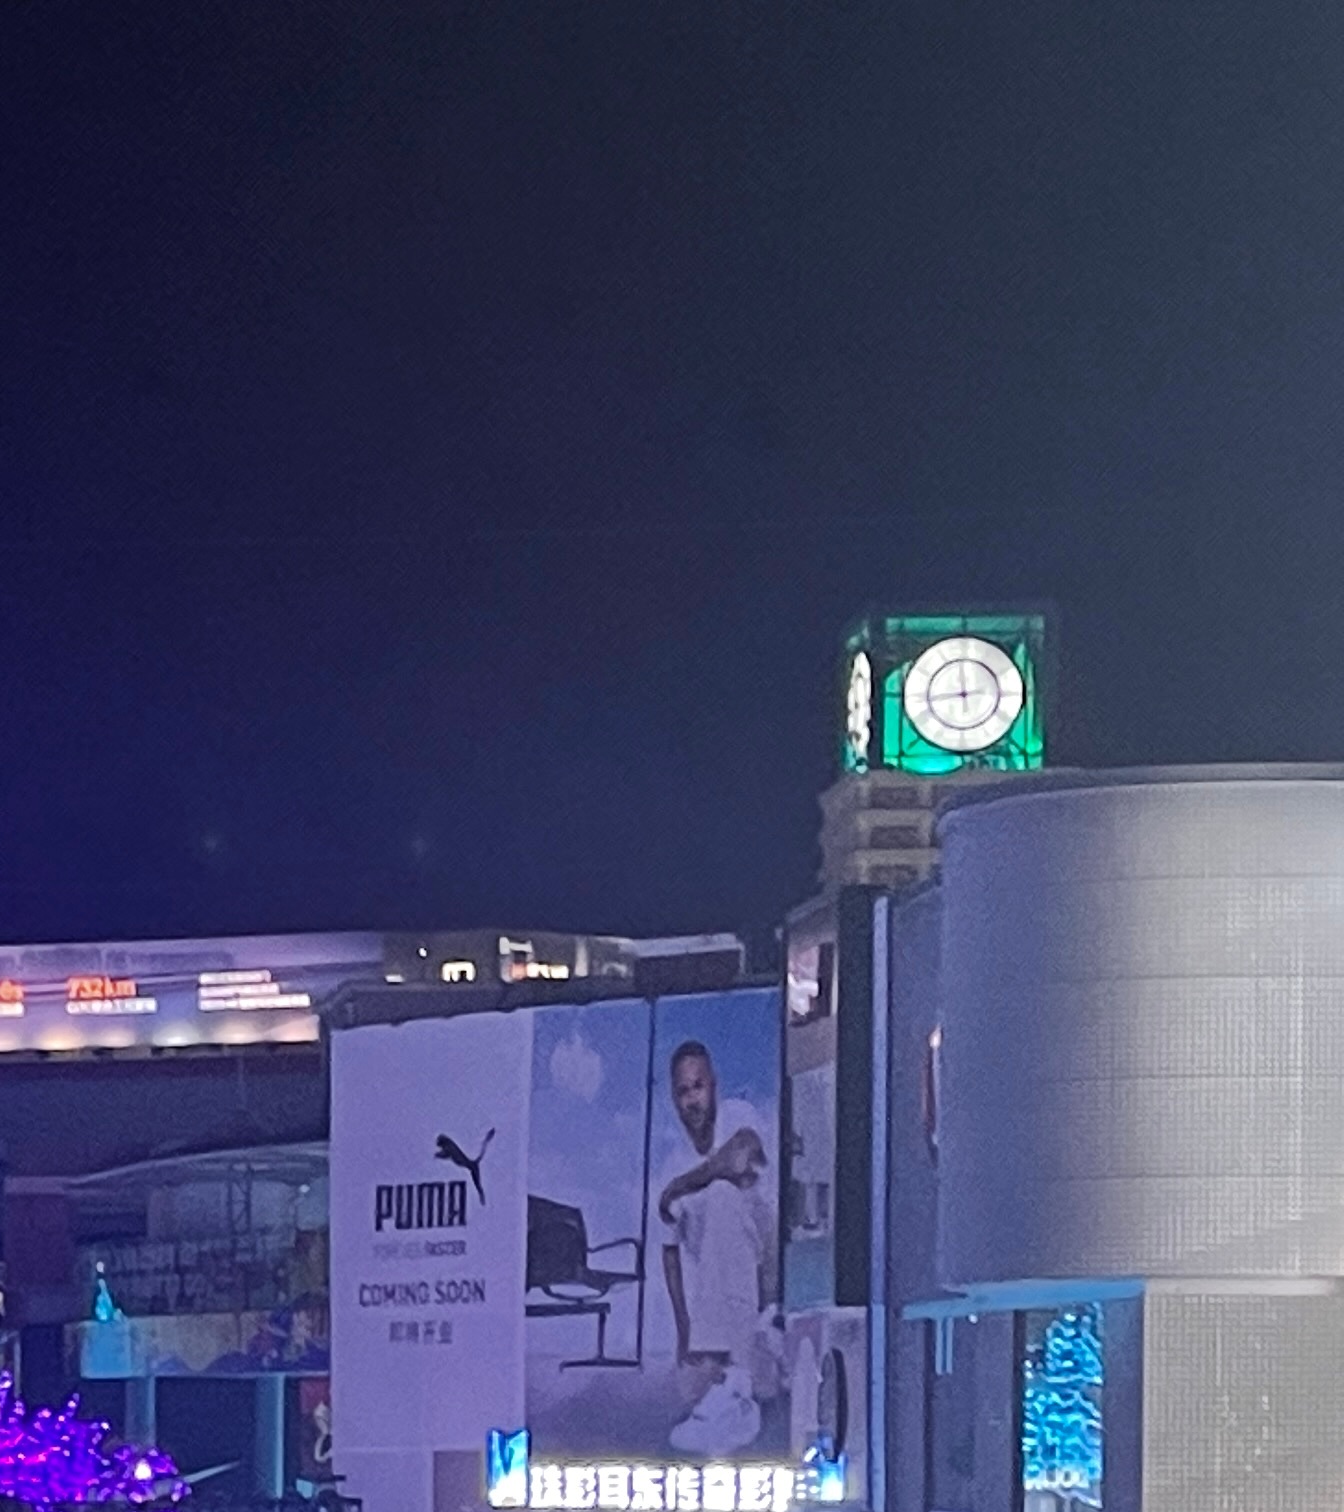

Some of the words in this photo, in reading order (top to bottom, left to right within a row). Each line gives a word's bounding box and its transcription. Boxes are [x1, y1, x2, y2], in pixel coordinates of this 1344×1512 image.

[375, 1181, 467, 1232] PUMA
[359, 1281, 430, 1307] COMING
[434, 1279, 486, 1305] SOON
